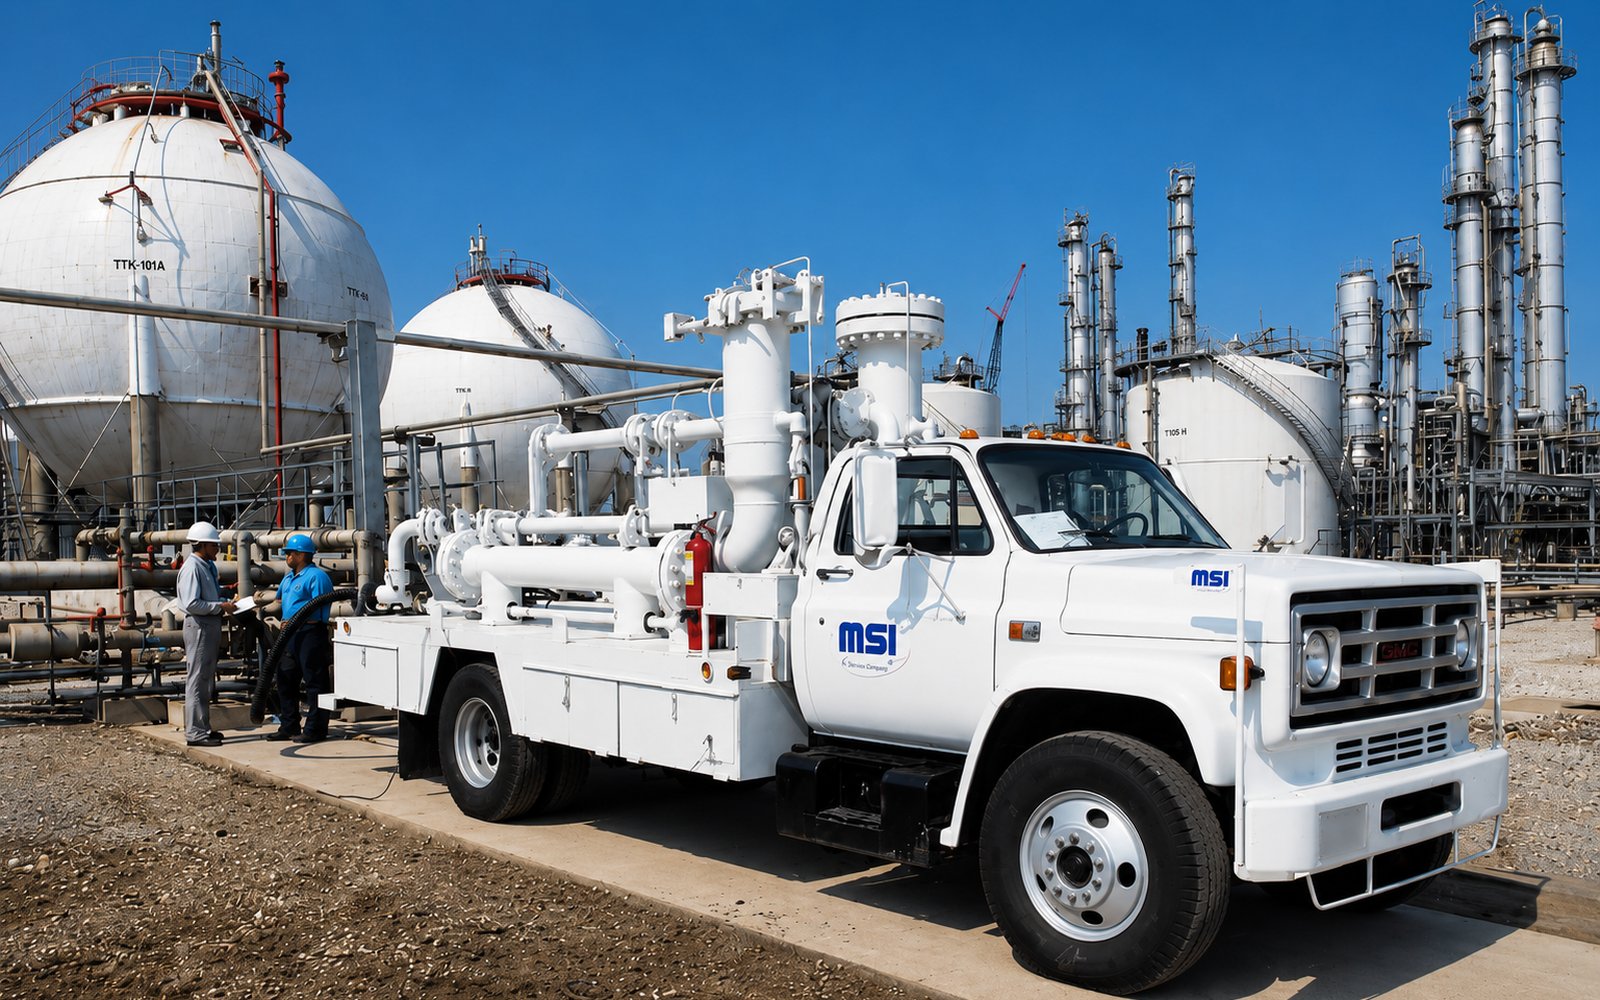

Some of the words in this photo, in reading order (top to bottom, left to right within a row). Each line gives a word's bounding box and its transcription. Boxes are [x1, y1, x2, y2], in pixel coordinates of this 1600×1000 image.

[113, 259, 166, 271] TTK-101A
[1191, 569, 1229, 587] MSI
[839, 621, 896, 656] MSI
